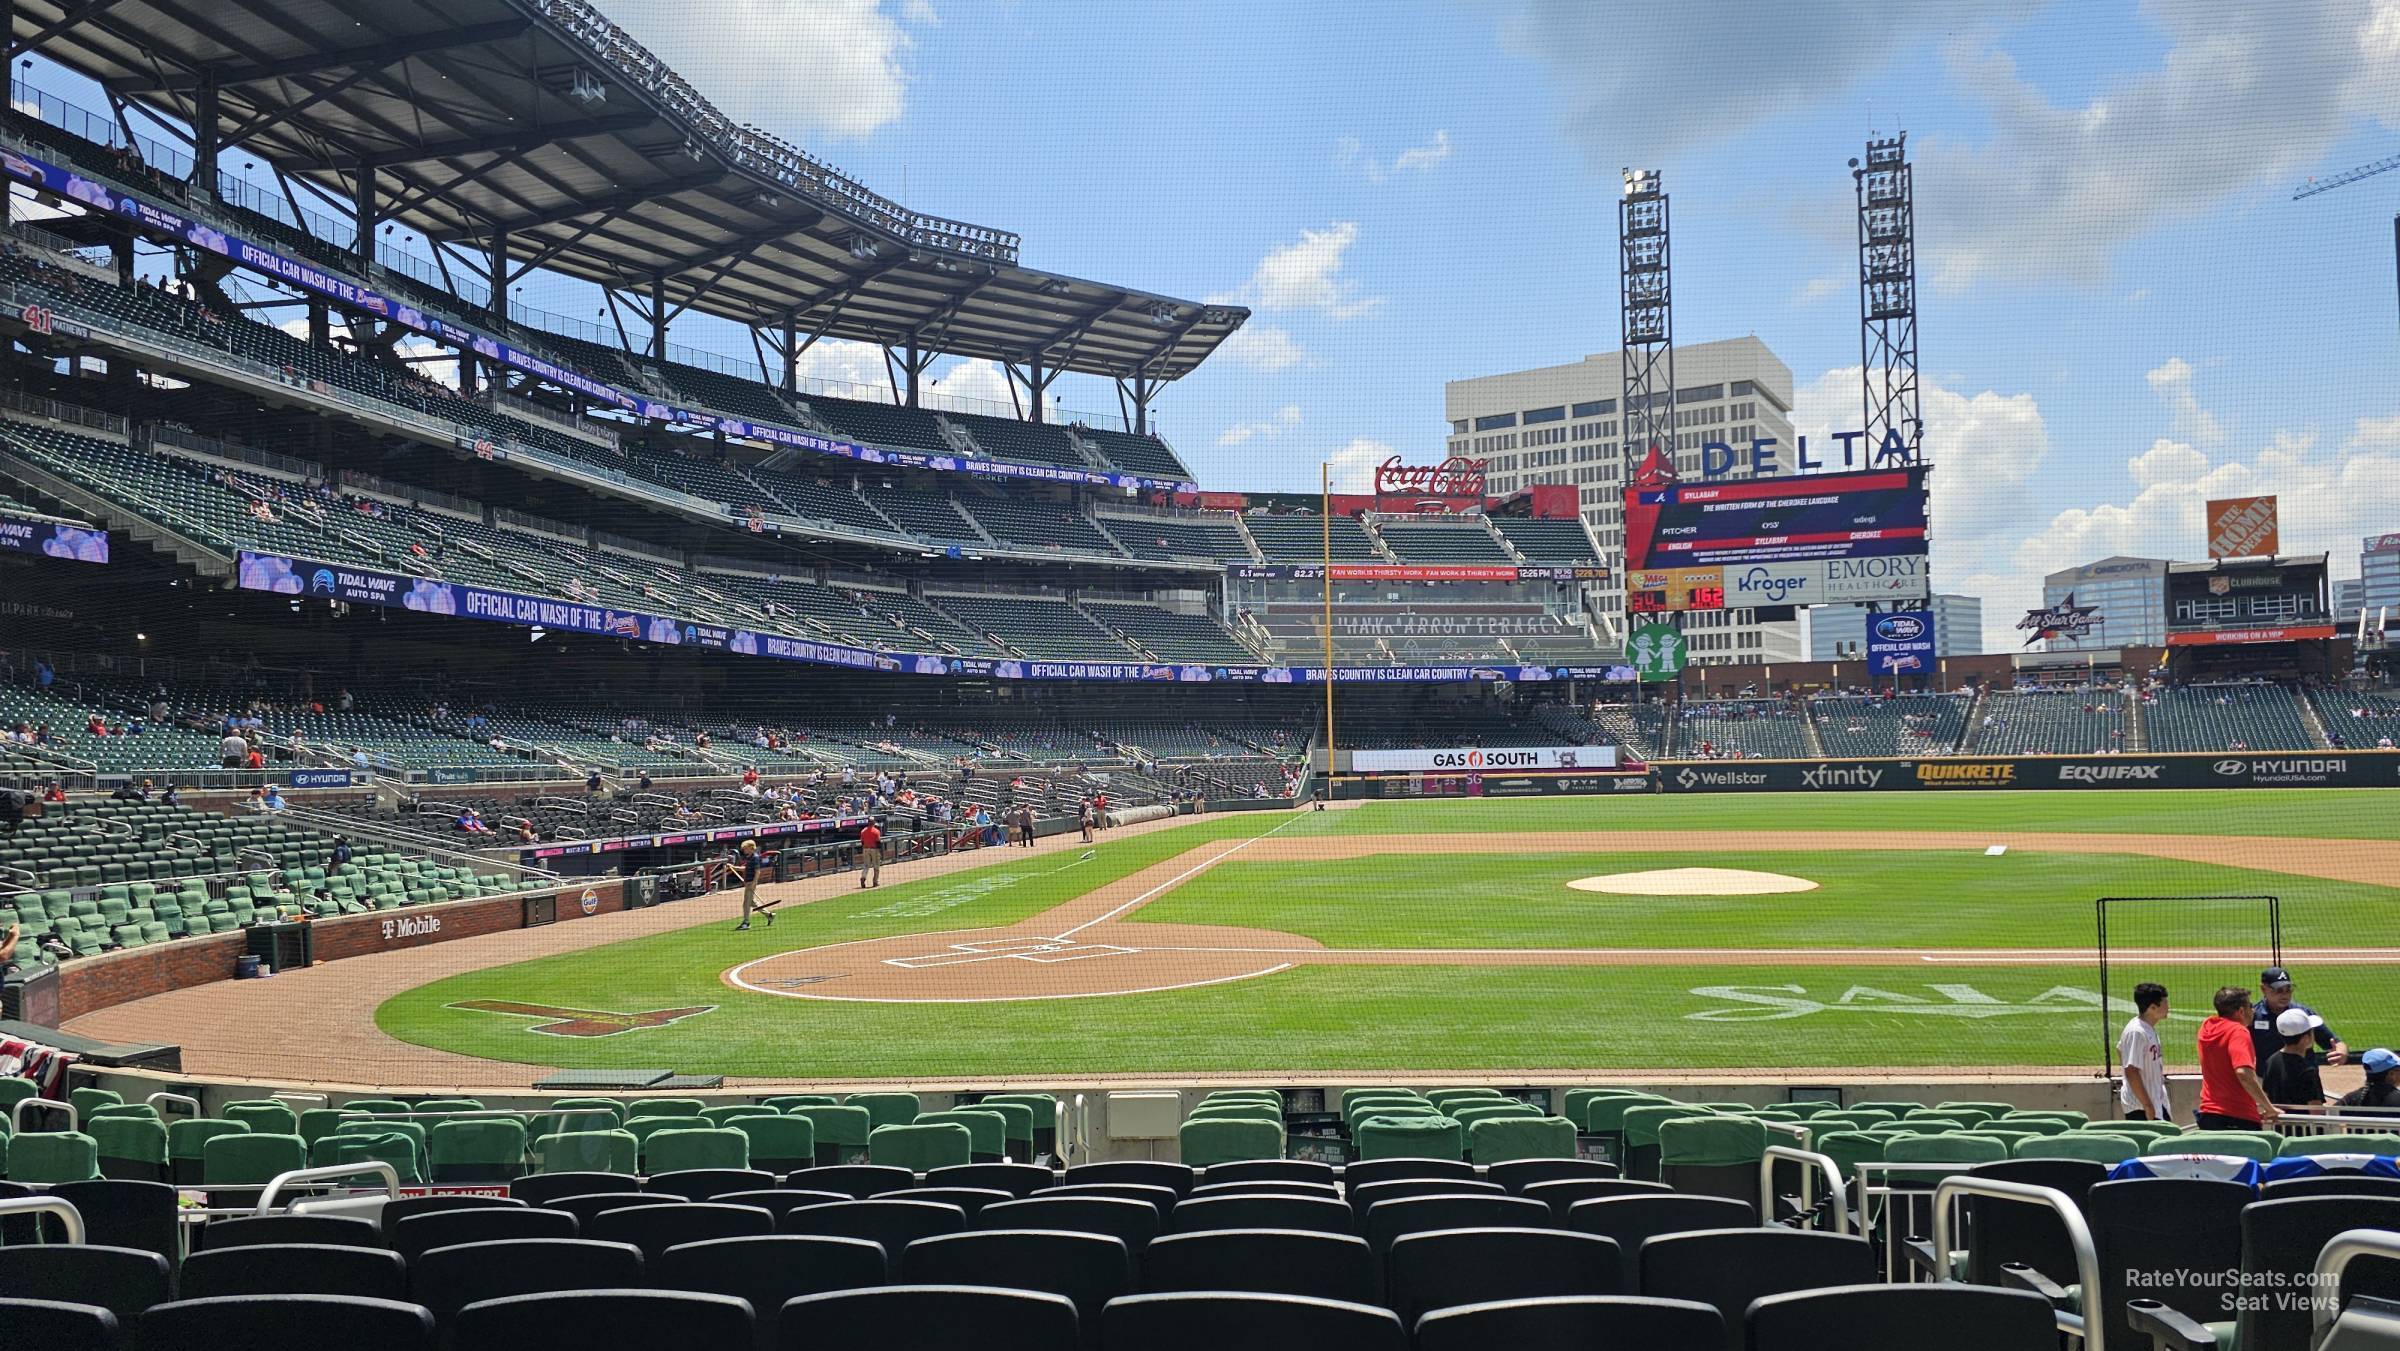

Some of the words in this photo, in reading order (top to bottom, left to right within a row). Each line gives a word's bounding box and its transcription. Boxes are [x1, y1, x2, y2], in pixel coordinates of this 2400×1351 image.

[138, 203, 161, 220] TIDAL
[161, 211, 183, 229] WAVE
[145, 216, 162, 229] AUTO
[163, 222, 175, 232] SPA
[242, 244, 281, 273] OFFICIAL
[282, 260, 300, 280] CAR
[301, 267, 326, 290] WASH
[327, 278, 337, 294] OF
[338, 282, 354, 301] THE
[23, 304, 52, 335] 41
[51, 318, 88, 338] MATHEWS
[442, 323, 455, 336] TIDAL
[455, 328, 470, 341] WAVE
[508, 349, 531, 370] BRAVES
[531, 358, 557, 379] COUNTRY
[557, 367, 564, 380] IS
[564, 369, 581, 388] CLEAN
[581, 376, 592, 393] CAR
[592, 381, 615, 401] COUNTRY
[752, 426, 779, 441] OFFICIAL
[779, 430, 791, 443] CAR
[792, 432, 809, 447] WASH
[809, 436, 817, 448] OF
[817, 438, 828, 450] THE
[474, 439, 493, 461] 44
[1702, 428, 1912, 476] DELTA
[965, 460, 990, 472] BRAVES
[991, 462, 1018, 475] COUNTRY
[1019, 465, 1025, 476] IS
[1025, 466, 1044, 478] CLEAN
[1045, 468, 1057, 479] CAR
[1057, 469, 1084, 482] COUNTRY
[1684, 490, 1720, 499] SYLLABARY
[1703, 504, 1715, 512] THE
[1715, 503, 1740, 511] WRITTEN
[1740, 501, 1757, 510] FORM
[1766, 500, 1777, 508] THE
[1778, 498, 1808, 507] CHEROKEE
[1808, 496, 1839, 505] LANGUAGE
[2214, 504, 2242, 530] THE
[0, 523, 33, 539] WAVE
[748, 518, 764, 533] 47
[1662, 526, 1697, 535] PITCHER
[2209, 496, 2276, 558] HOME
[1755, 536, 1788, 545] SYLLABARY
[1850, 530, 1882, 539] CHEROKEE
[2236, 517, 2277, 556] DEPOT
[1668, 542, 1693, 550] ENGLISH
[1239, 569, 1253, 577] 5.1
[1294, 569, 1314, 578] 82.2
[1518, 569, 1538, 578] 12:26
[1538, 569, 1551, 577] PM
[1828, 555, 1921, 580] EMORY
[338, 572, 367, 590] TIDAL
[368, 577, 396, 592] WAVE
[1738, 567, 1807, 601] Kroger
[1828, 578, 1917, 592] HEALTHCARE
[2231, 576, 2281, 587] CLUBHOUSE
[346, 589, 368, 599] AUTO
[370, 592, 386, 602] SPA
[1694, 587, 1724, 605] 162
[466, 591, 516, 619] OFFICIAL
[516, 599, 538, 622] CAR
[539, 603, 569, 627] WASH
[570, 608, 582, 628] OF
[583, 609, 601, 630] THE
[604, 610, 640, 636] Braves
[2016, 614, 2041, 629] All
[2041, 613, 2067, 628] Star
[2068, 612, 2104, 629] Game
[697, 627, 711, 638] TIDAL
[711, 630, 727, 640] WAVE
[1338, 616, 1394, 634] HANK
[1397, 616, 1466, 635] AARON
[1465, 616, 1561, 634] TERRACE
[2215, 632, 2249, 641] WORKING
[767, 637, 790, 657] BRAVES
[791, 641, 817, 660] COUNTRY
[817, 645, 823, 660] IS
[823, 646, 840, 662] CLEAN
[840, 649, 851, 664] CAR
[851, 650, 874, 667] COUNTRY
[1871, 643, 1898, 652] OFFICIAL
[1898, 643, 1911, 651] CAR
[1912, 642, 1931, 650] WASH
[962, 661, 976, 669] TIDAL
[976, 662, 991, 670] WAVE
[1031, 664, 1069, 677] OFFICIAL
[1069, 664, 1086, 678] CAR
[1087, 665, 1110, 678] WASH
[1110, 666, 1122, 678] OF
[1123, 666, 1139, 679] THE
[1228, 668, 1242, 676] TIDAL
[1242, 668, 1258, 676] WAVE
[1339, 668, 1376, 680] COUNTRY
[1377, 668, 1385, 680] IS
[1387, 668, 1413, 680] CLEAN
[1414, 667, 1433, 680] CAR
[1433, 667, 1468, 680] COUNTRY
[1433, 753, 1466, 767] GAS
[1486, 752, 1538, 767] SOUTH
[2252, 760, 2346, 773] HYUNDAI
[310, 774, 347, 783] HYUNDAI
[1701, 771, 1768, 785] Wellstar
[1801, 764, 1883, 789] xfinity
[1916, 764, 2015, 780] QUIKRETE
[2058, 765, 2160, 783] EQUIFAX
[2252, 774, 2326, 782] HyundaiUSA.com
[583, 897, 598, 906] Gulf
[382, 920, 394, 940] T
[396, 915, 441, 938] Mobile
